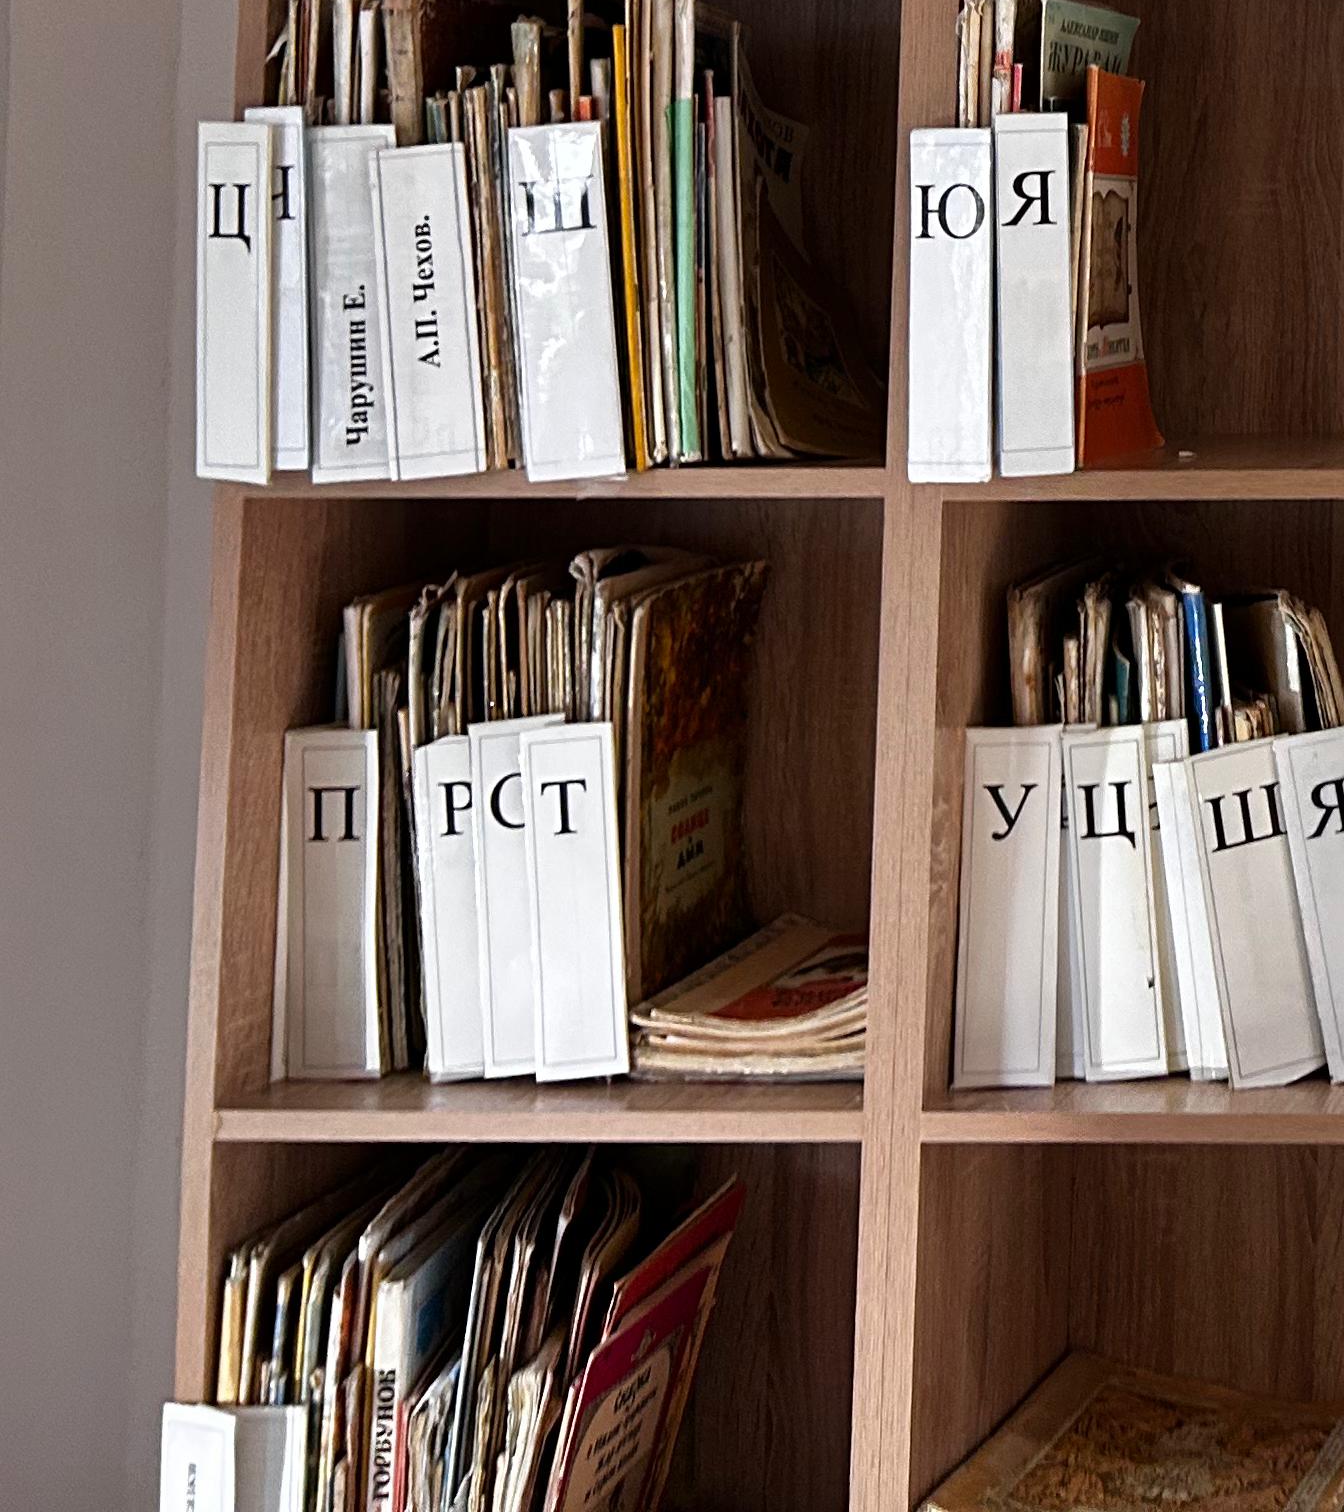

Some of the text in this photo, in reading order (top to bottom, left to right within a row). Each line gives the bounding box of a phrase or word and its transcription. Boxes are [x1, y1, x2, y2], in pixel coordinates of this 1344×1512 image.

[208, 183, 252, 254] Ц
[519, 176, 598, 237] Ш
[914, 184, 986, 240] Ю
[1001, 171, 1058, 227] Я
[412, 213, 441, 368] А.П. Чехов.
[341, 284, 378, 447] Чарушин Е.
[308, 785, 361, 843] П
[438, 781, 474, 838] Р
[540, 778, 587, 836] Т
[983, 784, 1039, 841] У
[1076, 780, 1137, 849] Ц
[1204, 781, 1287, 854] Ш
